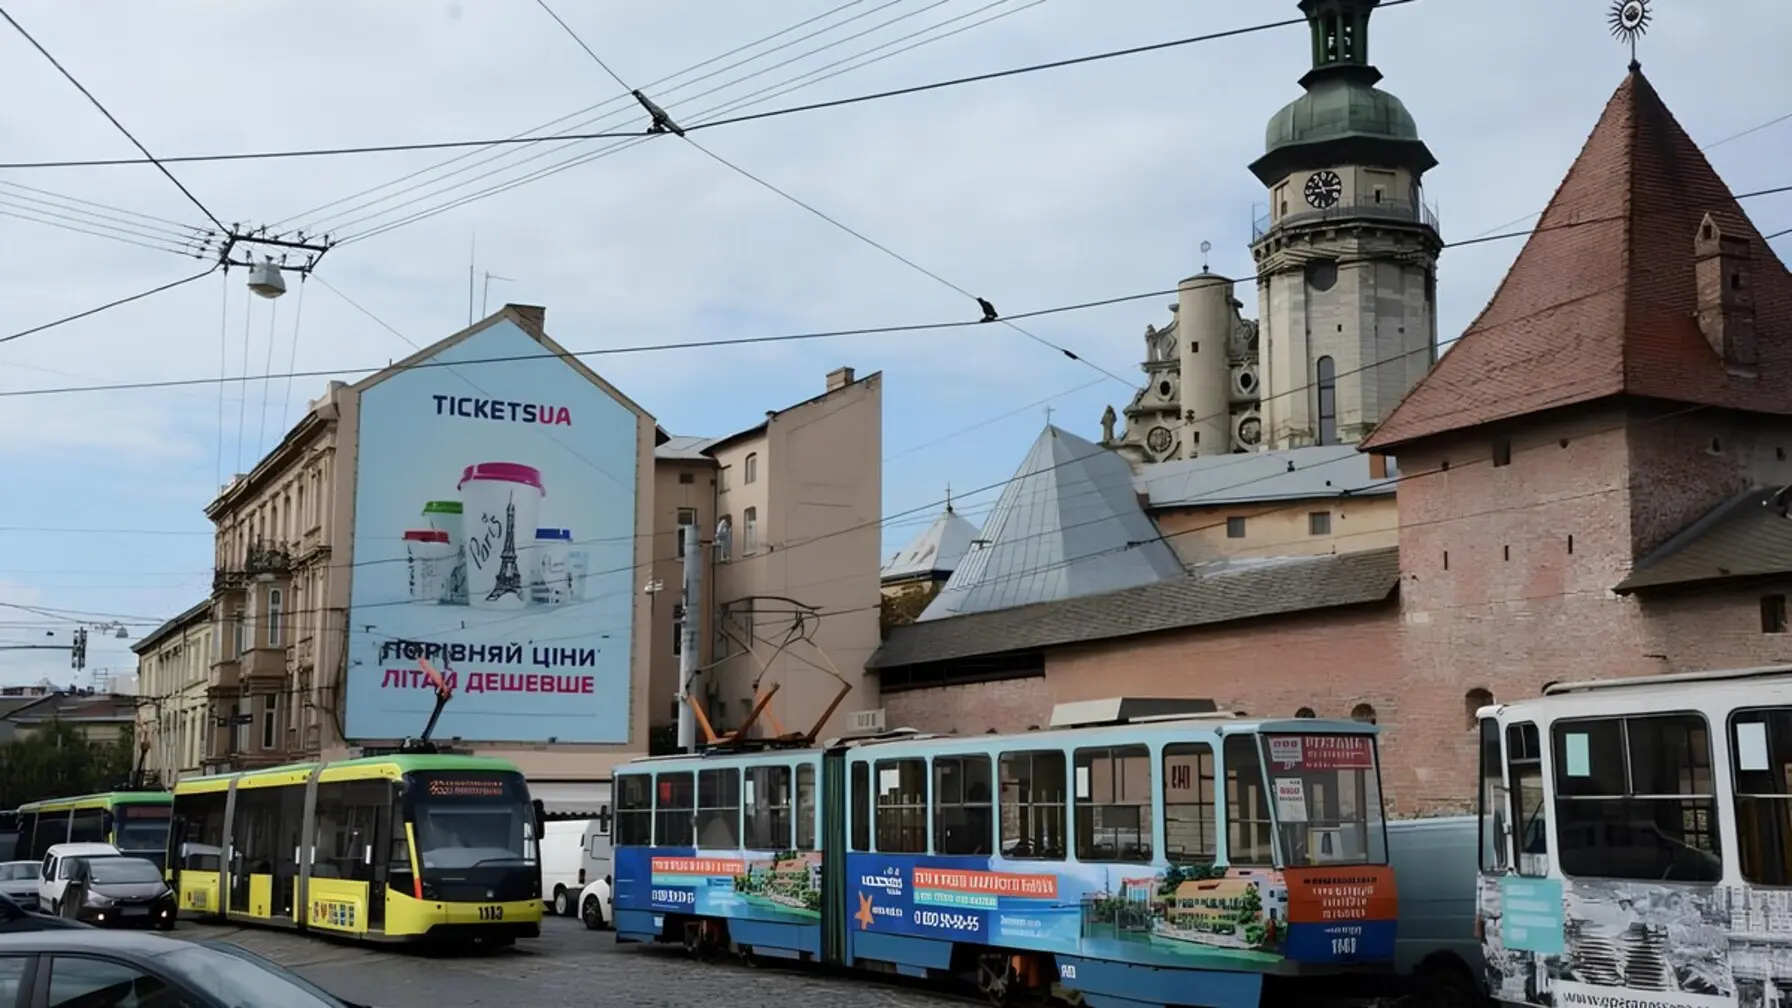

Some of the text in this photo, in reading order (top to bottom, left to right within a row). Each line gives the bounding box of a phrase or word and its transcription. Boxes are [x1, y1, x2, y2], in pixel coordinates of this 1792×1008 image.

[432, 394, 572, 426] TICKETSUA
[469, 512, 503, 570] Paris
[532, 647, 595, 668] ЦІНИ
[464, 672, 595, 694] ДЕШЕВШЕ
